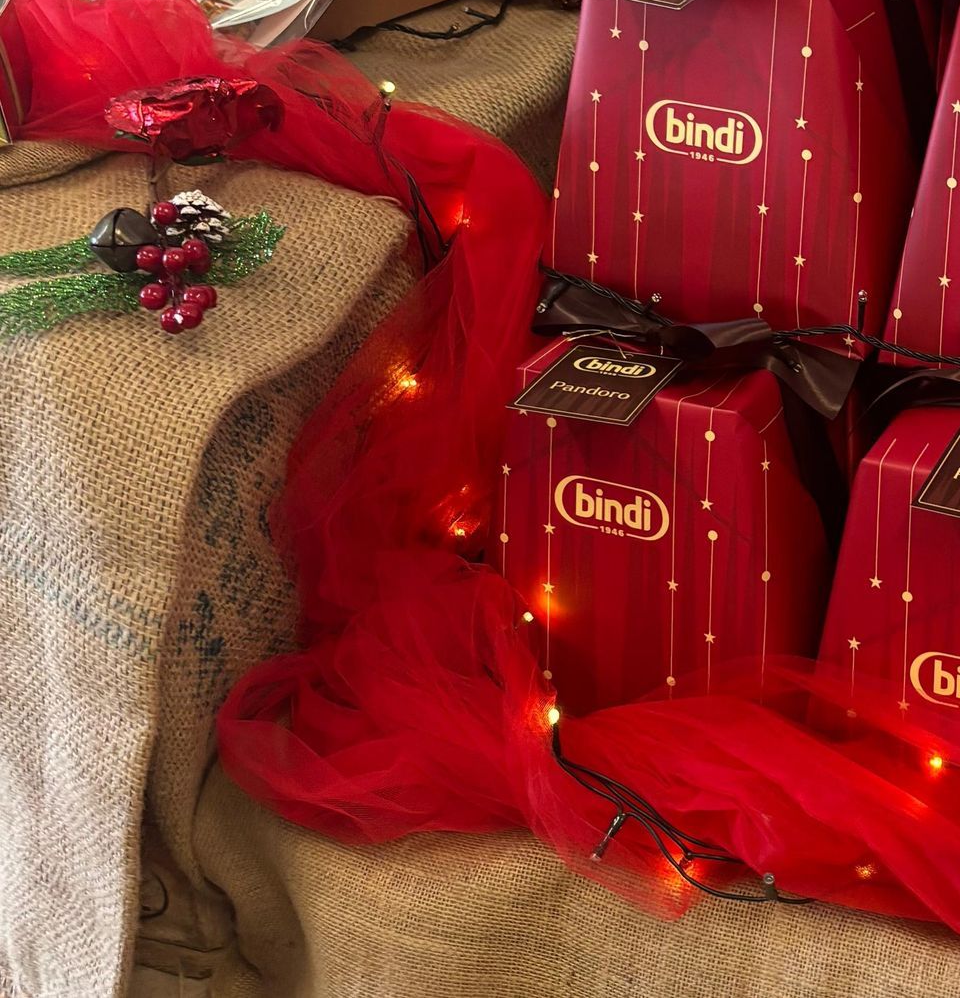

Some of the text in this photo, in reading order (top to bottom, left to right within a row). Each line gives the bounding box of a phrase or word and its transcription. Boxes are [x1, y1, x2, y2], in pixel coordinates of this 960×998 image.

[666, 107, 745, 154] bindi
[689, 151, 715, 163] 1946
[585, 359, 646, 376] bindi
[549, 380, 631, 400] Pandoro
[575, 482, 651, 531] bindi
[600, 525, 625, 538] 1946
